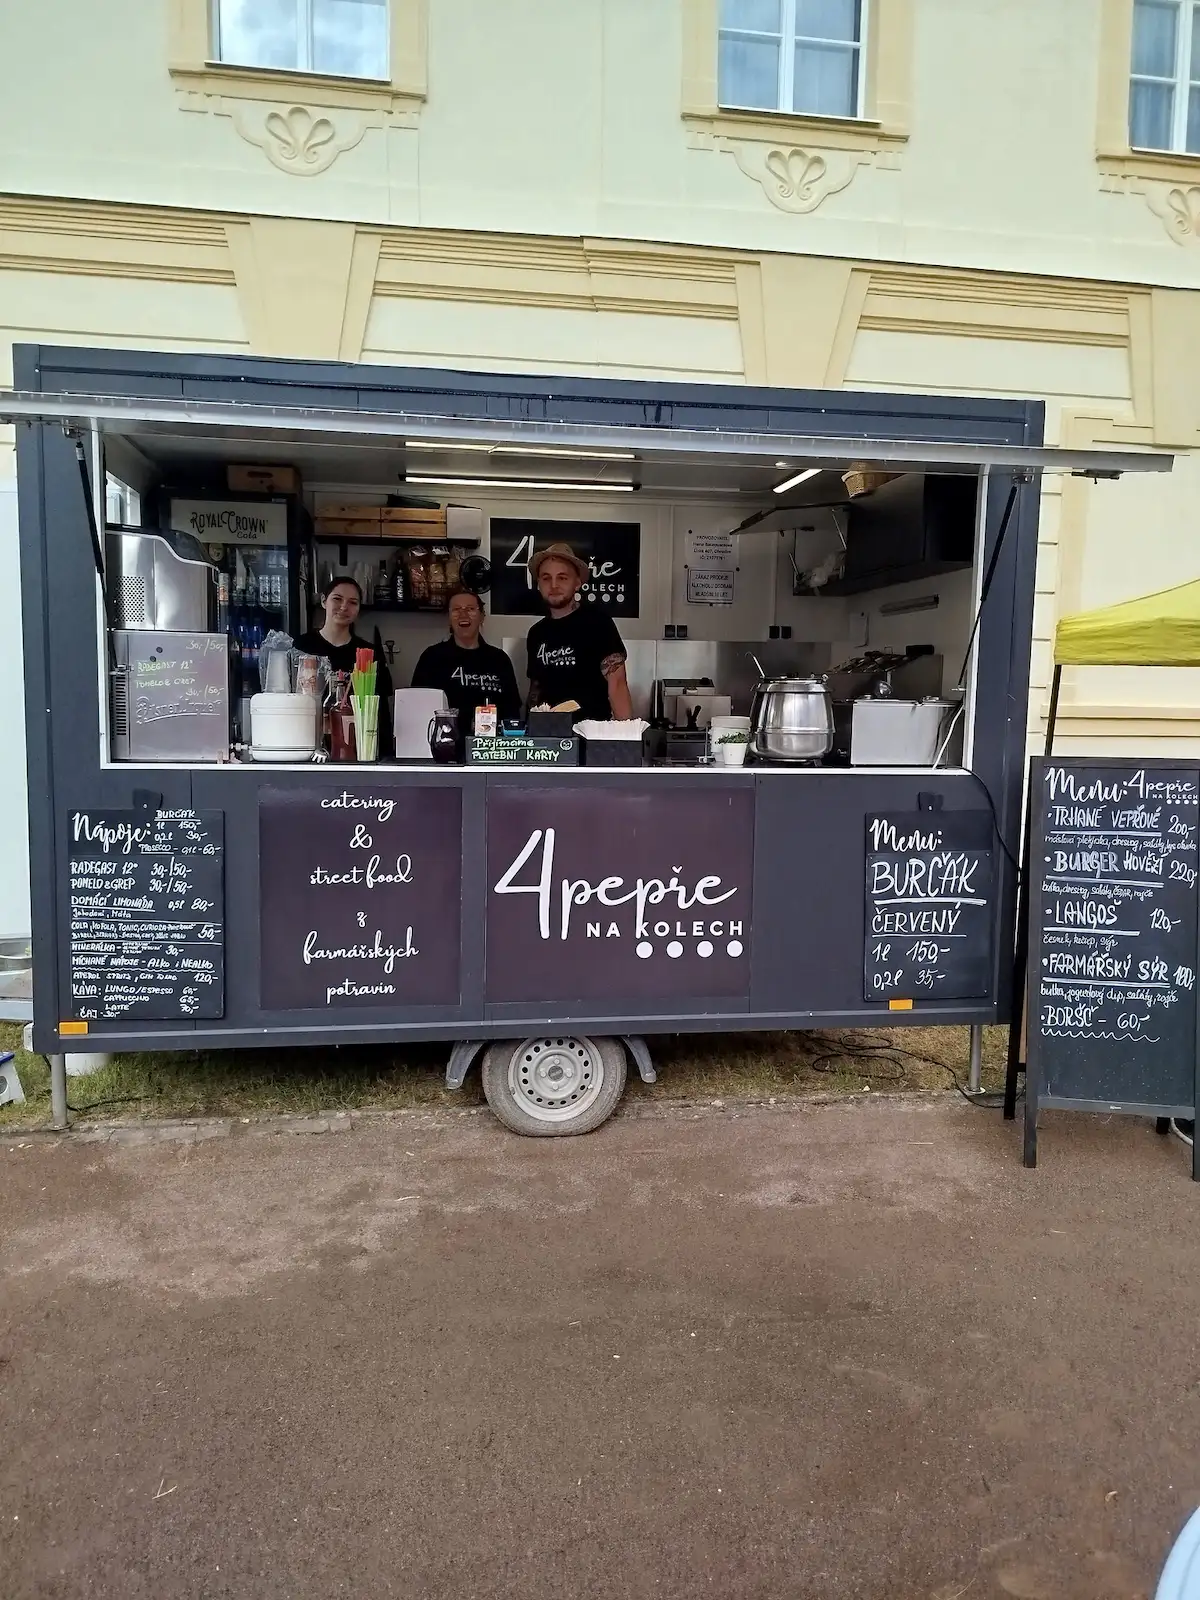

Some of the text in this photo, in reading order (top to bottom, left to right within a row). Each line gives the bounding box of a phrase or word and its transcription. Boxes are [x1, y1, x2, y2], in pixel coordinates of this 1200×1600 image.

[190, 511, 223, 534] ROYAL
[236, 530, 257, 539] Cola
[506, 534, 622, 590] 4ře
[581, 583, 625, 592] OLECH
[471, 748, 560, 761] PLATEBNÍ KARTY
[321, 790, 398, 822] catering
[1052, 804, 1108, 828] TRHANÉ
[1111, 804, 1162, 829] VEPŘOVÉ
[350, 824, 373, 849] &
[869, 818, 943, 852] Menu:
[70, 861, 117, 875] RADEGAST
[310, 853, 413, 889] street food
[870, 852, 979, 897] BURČÁK
[1052, 850, 1120, 878] BURGER
[494, 828, 738, 940] 4pepře
[71, 892, 112, 906] DOMÁCÍ
[113, 895, 154, 909] LIMONÁDA
[356, 911, 368, 928] z
[871, 901, 962, 934] ČERVENÝ
[1055, 899, 1182, 932] LANGOŠ 120,-
[586, 920, 743, 938] NA KOLECH
[303, 926, 419, 974] farmářských
[181, 959, 213, 969] NEALKO
[1049, 950, 1132, 979] FARMÁŘSKÝ
[1137, 956, 1169, 982] SÝR
[326, 978, 396, 1004] potravin
[915, 968, 946, 989] 35,-
[1042, 1002, 1100, 1027] BORŠČ
[1116, 1012, 1150, 1031] 60,-
